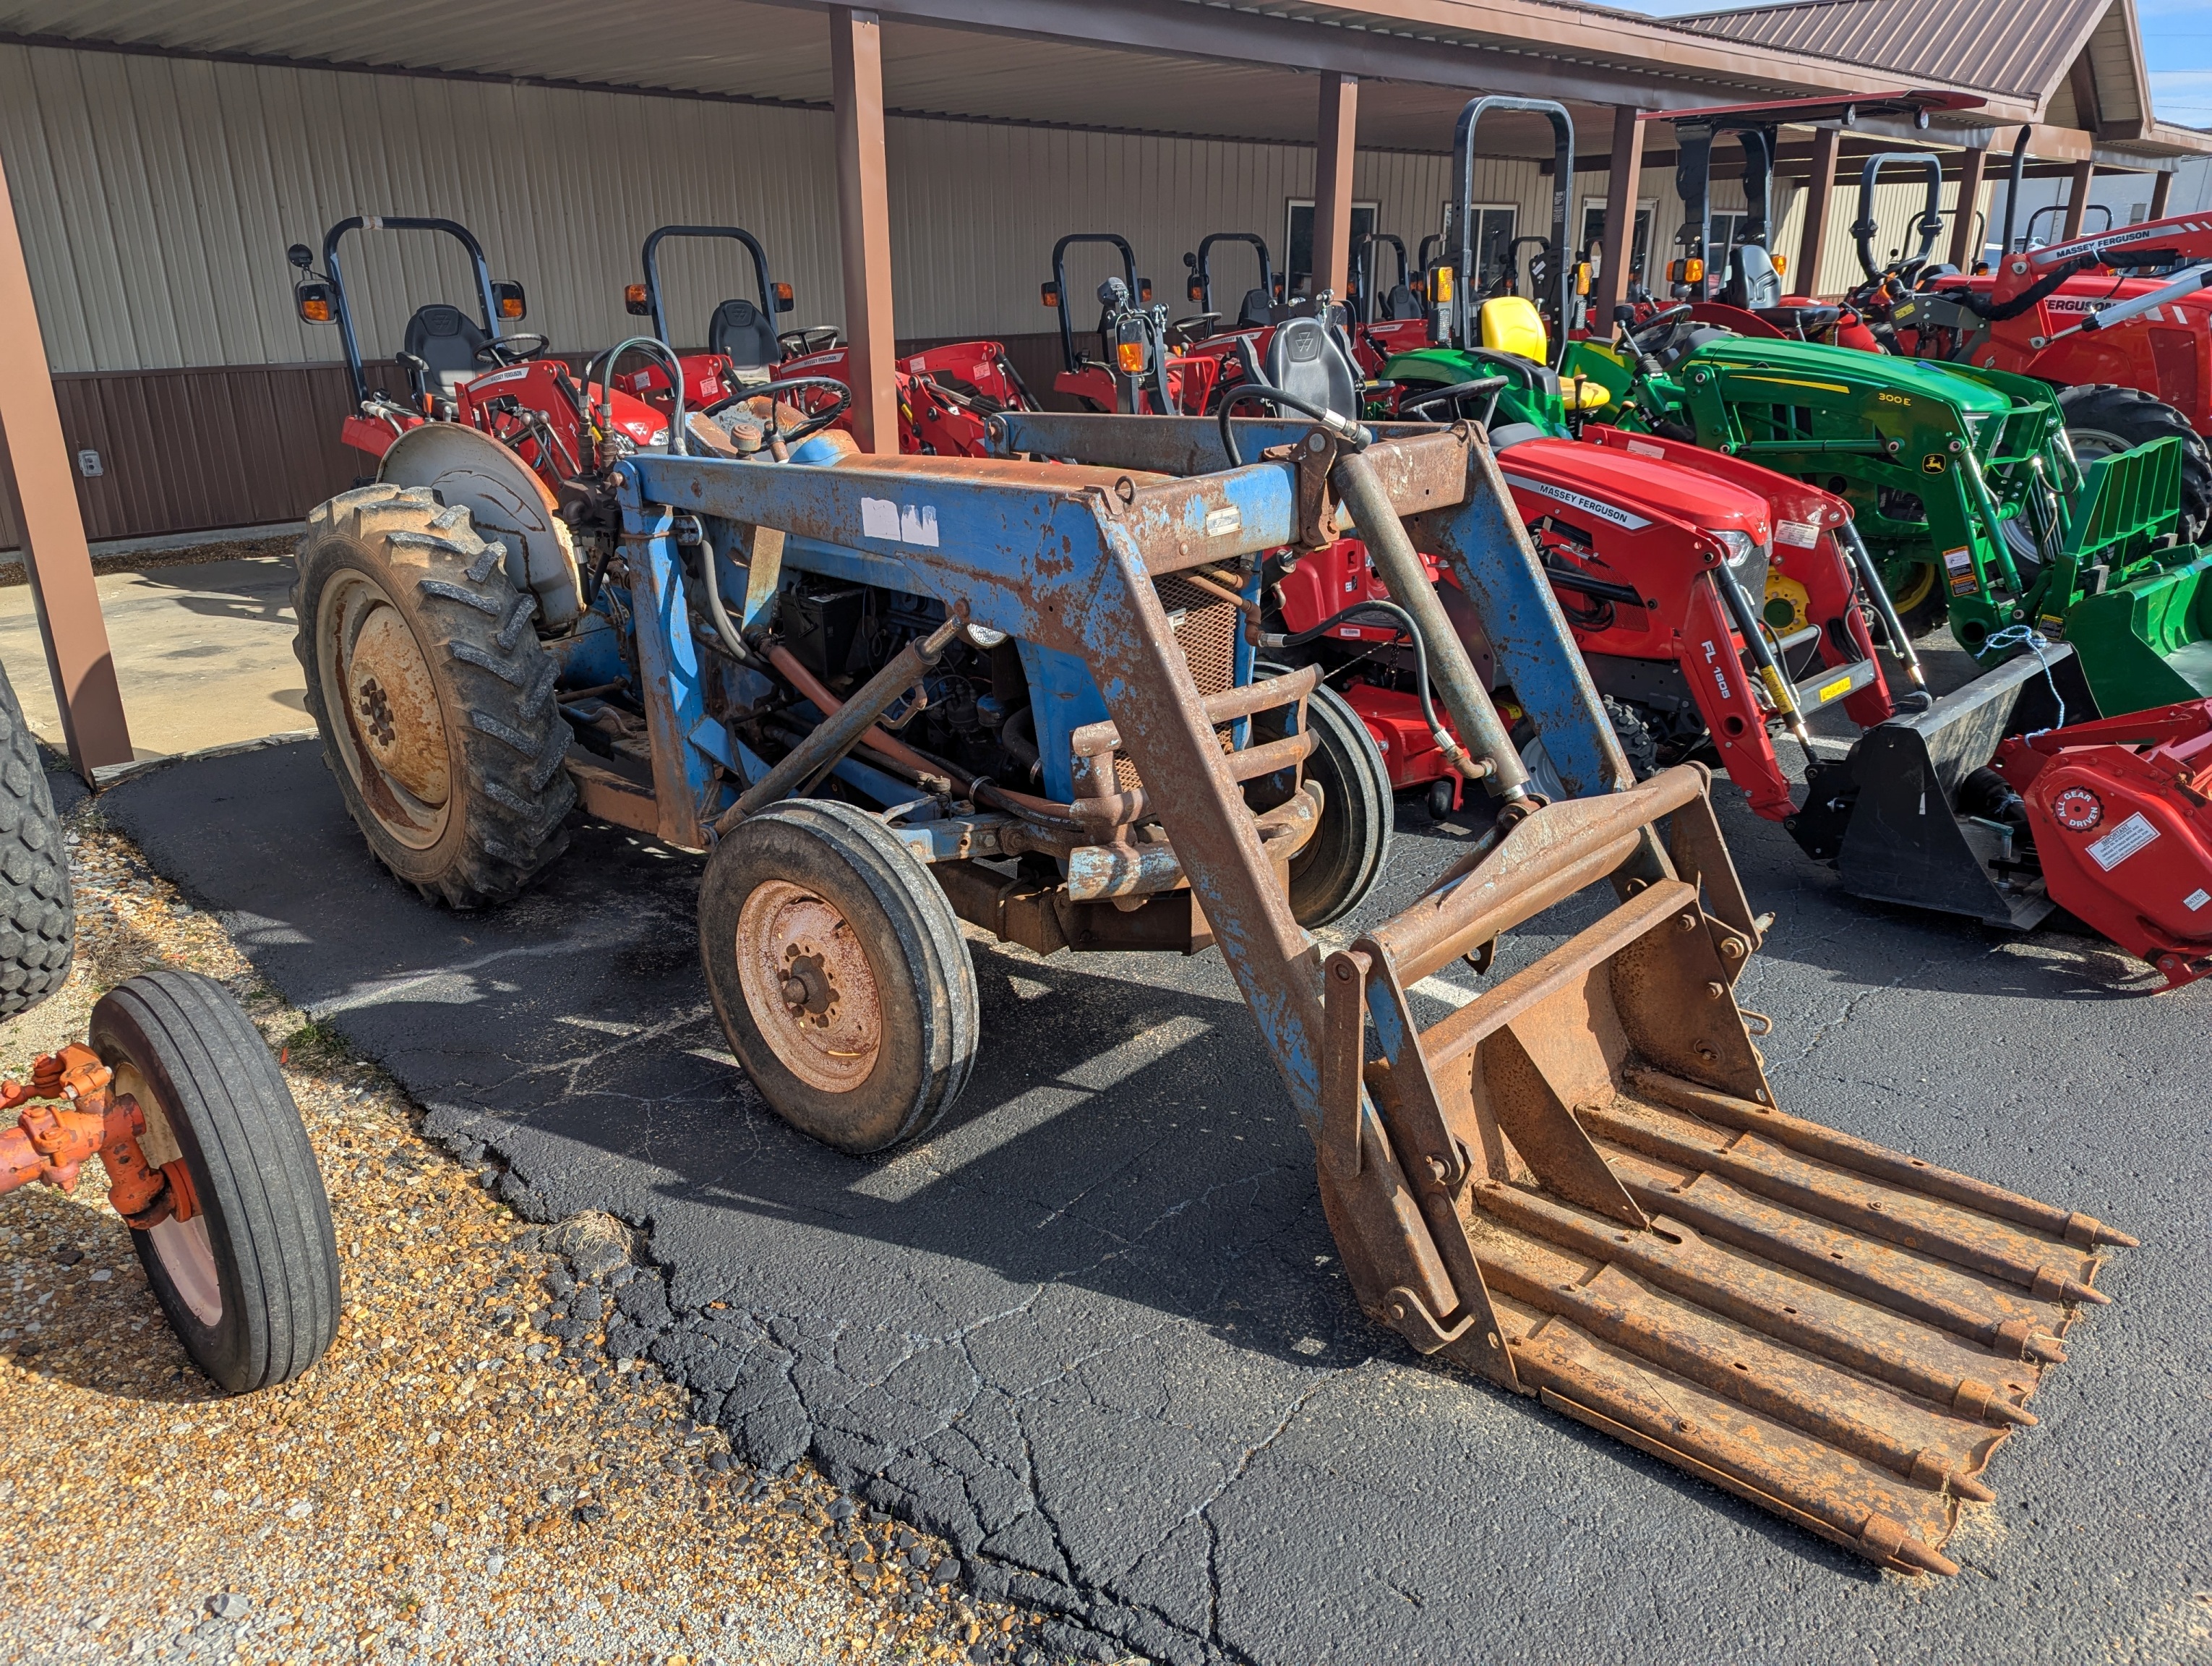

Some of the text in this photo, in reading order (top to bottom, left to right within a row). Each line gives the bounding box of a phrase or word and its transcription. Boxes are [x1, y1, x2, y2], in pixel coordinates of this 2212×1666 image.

[2057, 231, 2150, 258] MASSEY FERGUSON
[1540, 484, 1628, 523] MASSEY FERGUSON
[1701, 640, 1731, 699] FL 1805
[1027, 811, 1050, 819] HYDRAULIC
[2057, 791, 2098, 827] ALL GEAR DRIVEN
[2101, 824, 2130, 846] IMPORTANT
[2102, 849, 2114, 858] GREASE
[2113, 840, 2126, 850] FITTINGS
[2125, 832, 2138, 841] BEFORE
[2118, 842, 2130, 852] OWNERS
[2100, 845, 2110, 853] CHECK
[2186, 891, 2205, 906] PATENT
